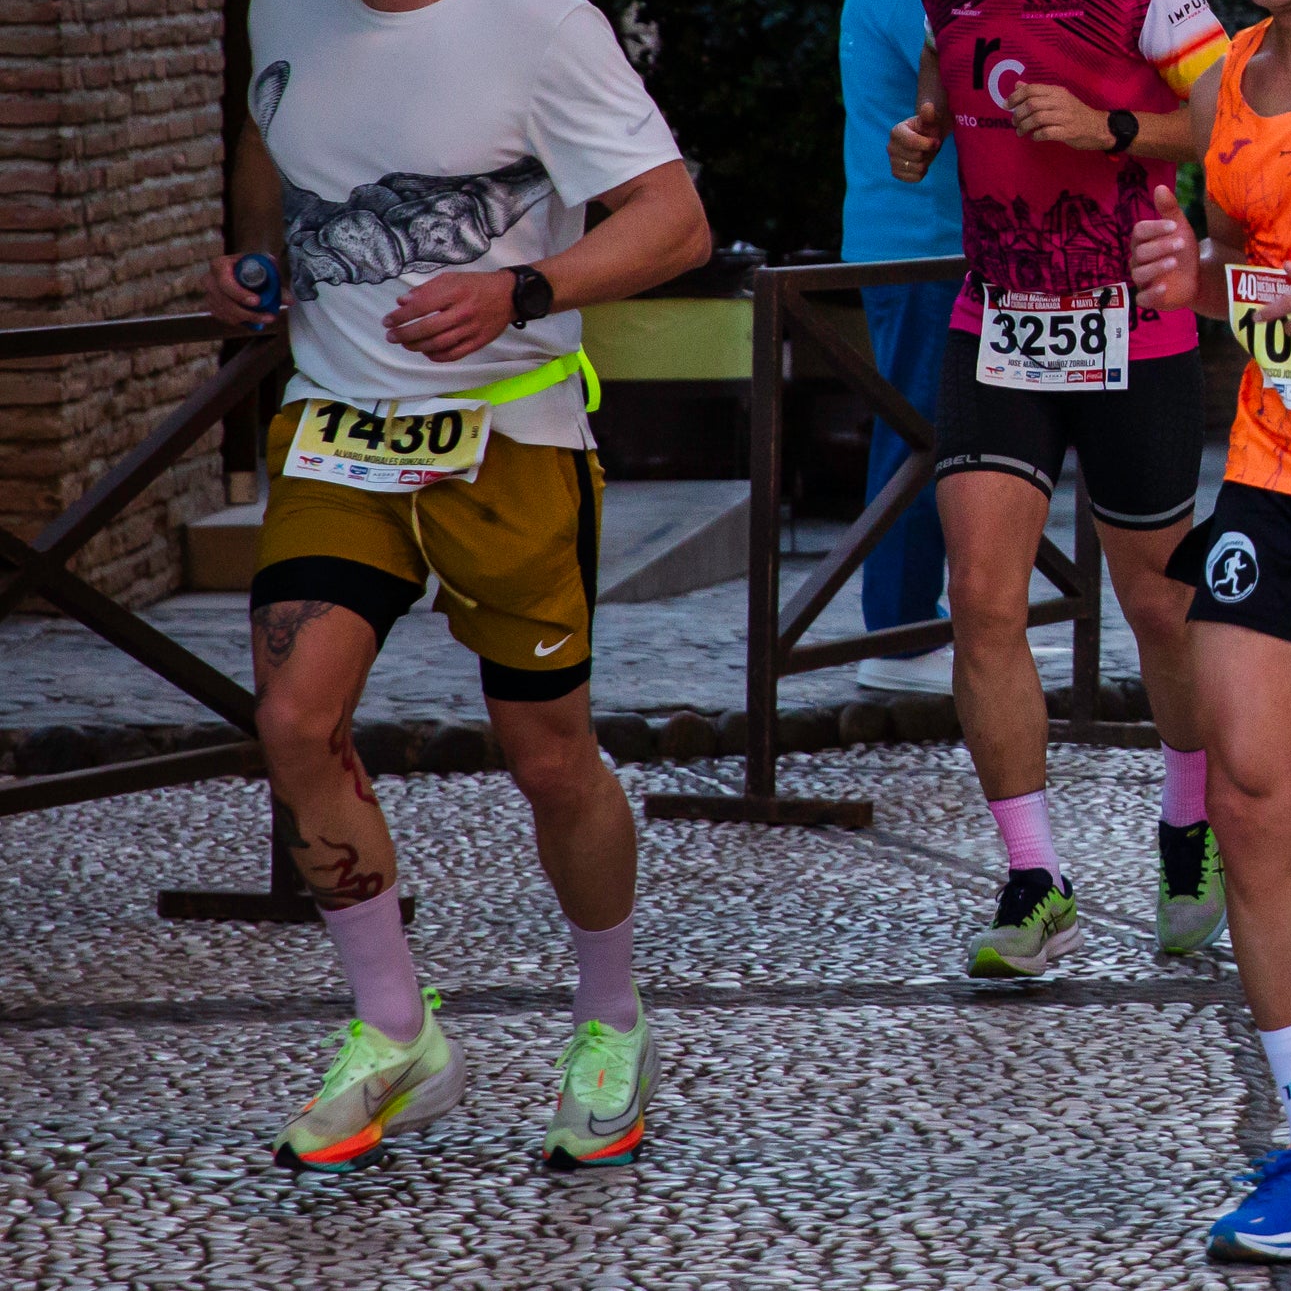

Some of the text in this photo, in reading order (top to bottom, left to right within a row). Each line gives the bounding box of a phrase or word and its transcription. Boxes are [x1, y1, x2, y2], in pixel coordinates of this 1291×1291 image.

[1237, 272, 1257, 301] 40
[1257, 282, 1277, 294] MEDIA
[1011, 292, 1029, 302] MEDIA
[1071, 299, 1076, 308] 4
[1076, 298, 1092, 308] MAYO
[1035, 301, 1061, 310] GRANADA
[989, 312, 1108, 356] 3258
[1008, 359, 1022, 368] JOSE
[1069, 359, 1096, 368] ZORRILLA
[316, 403, 463, 455] 1430
[333, 448, 436, 467] ALVARO MORALES GONZALEZ
